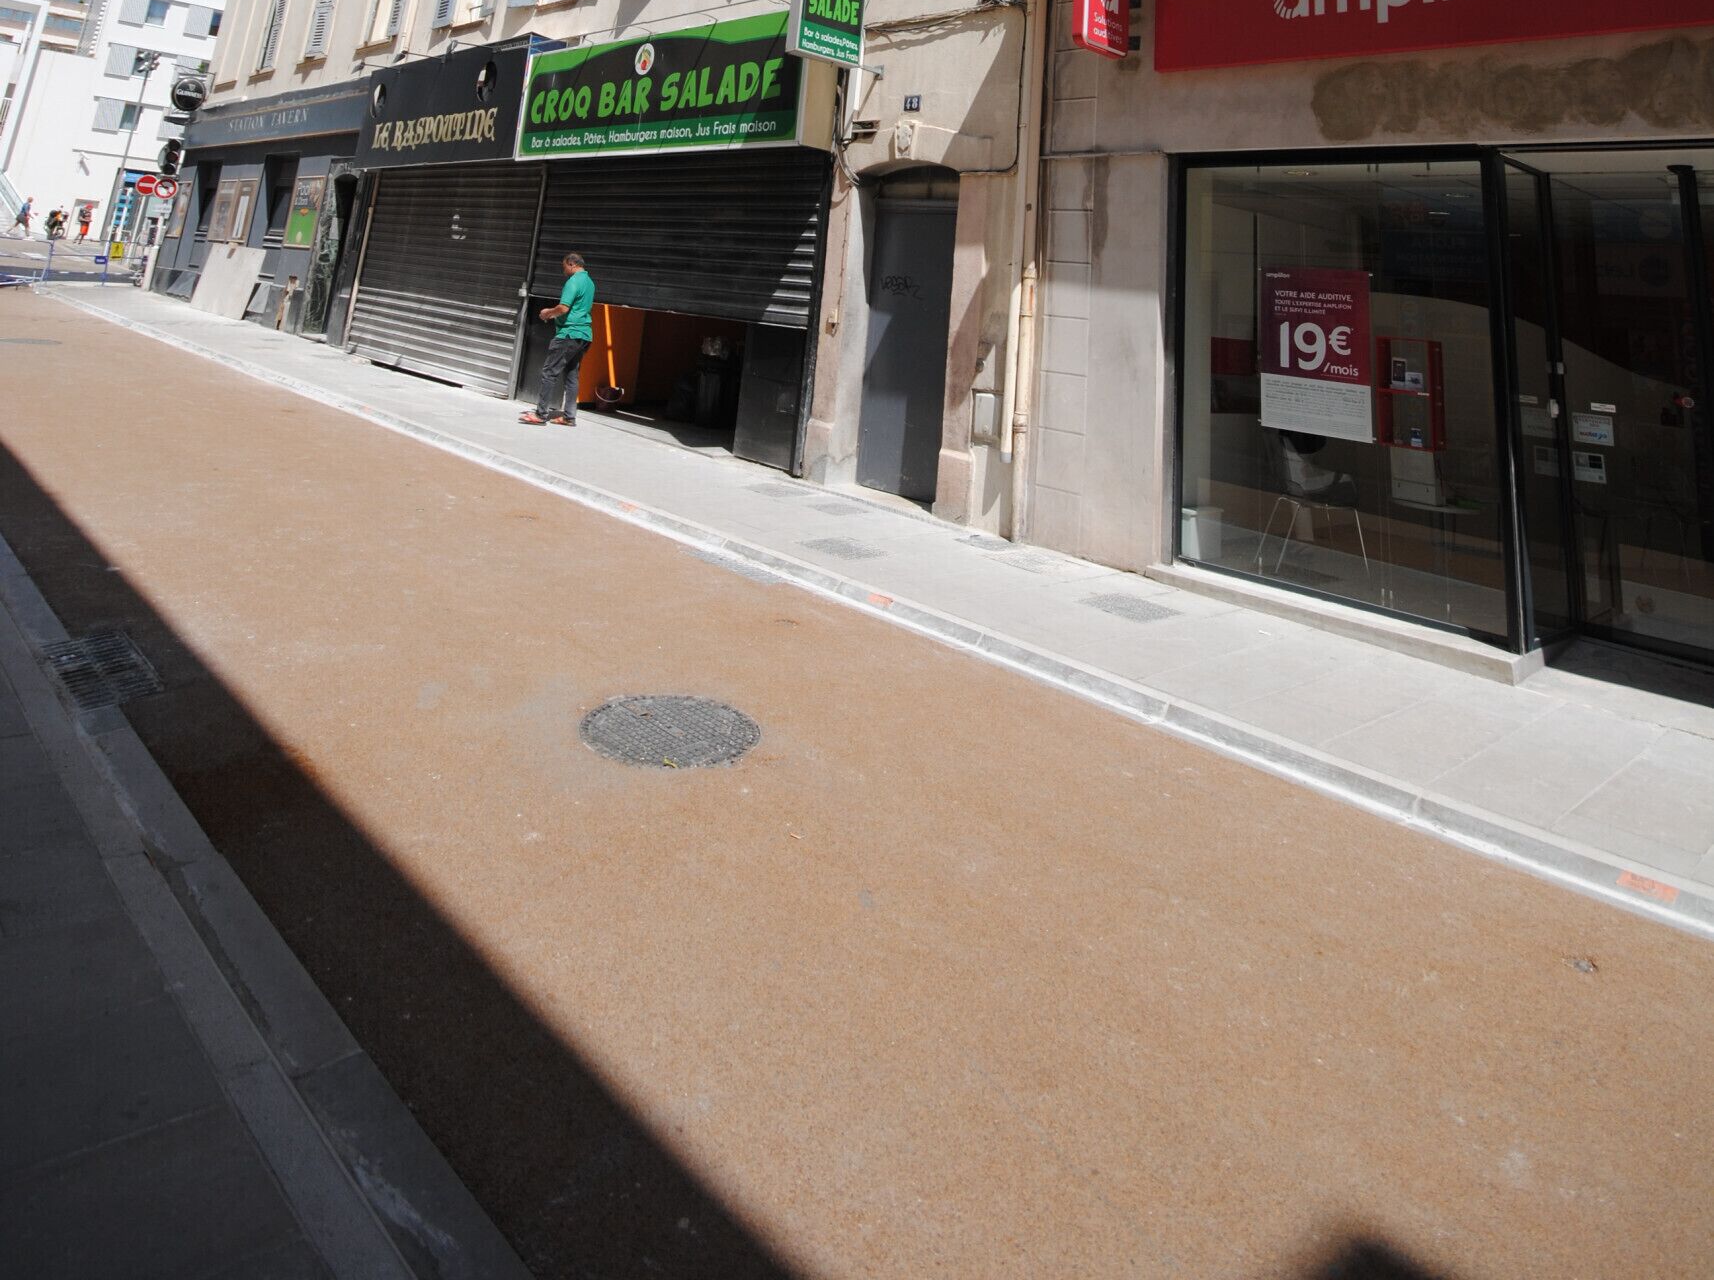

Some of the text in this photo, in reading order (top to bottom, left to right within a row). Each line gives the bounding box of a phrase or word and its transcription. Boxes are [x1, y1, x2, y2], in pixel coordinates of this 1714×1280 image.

[804, 27, 814, 37] Bar
[1094, 12, 1123, 32] Solutions
[1093, 27, 1122, 44] auditives
[836, 48, 845, 58] Jus
[531, 58, 784, 124] CROQ BAR SALADE
[229, 107, 309, 131] STATION TAVERN
[371, 107, 498, 151] LE RASPOUTINE
[532, 137, 543, 148] Bar
[609, 129, 657, 142] Hamburgers
[660, 127, 693, 138] maison,
[695, 123, 710, 136] Jus
[713, 121, 736, 135] Frais
[740, 120, 776, 133] maison
[1274, 290, 1298, 298] VOTRE
